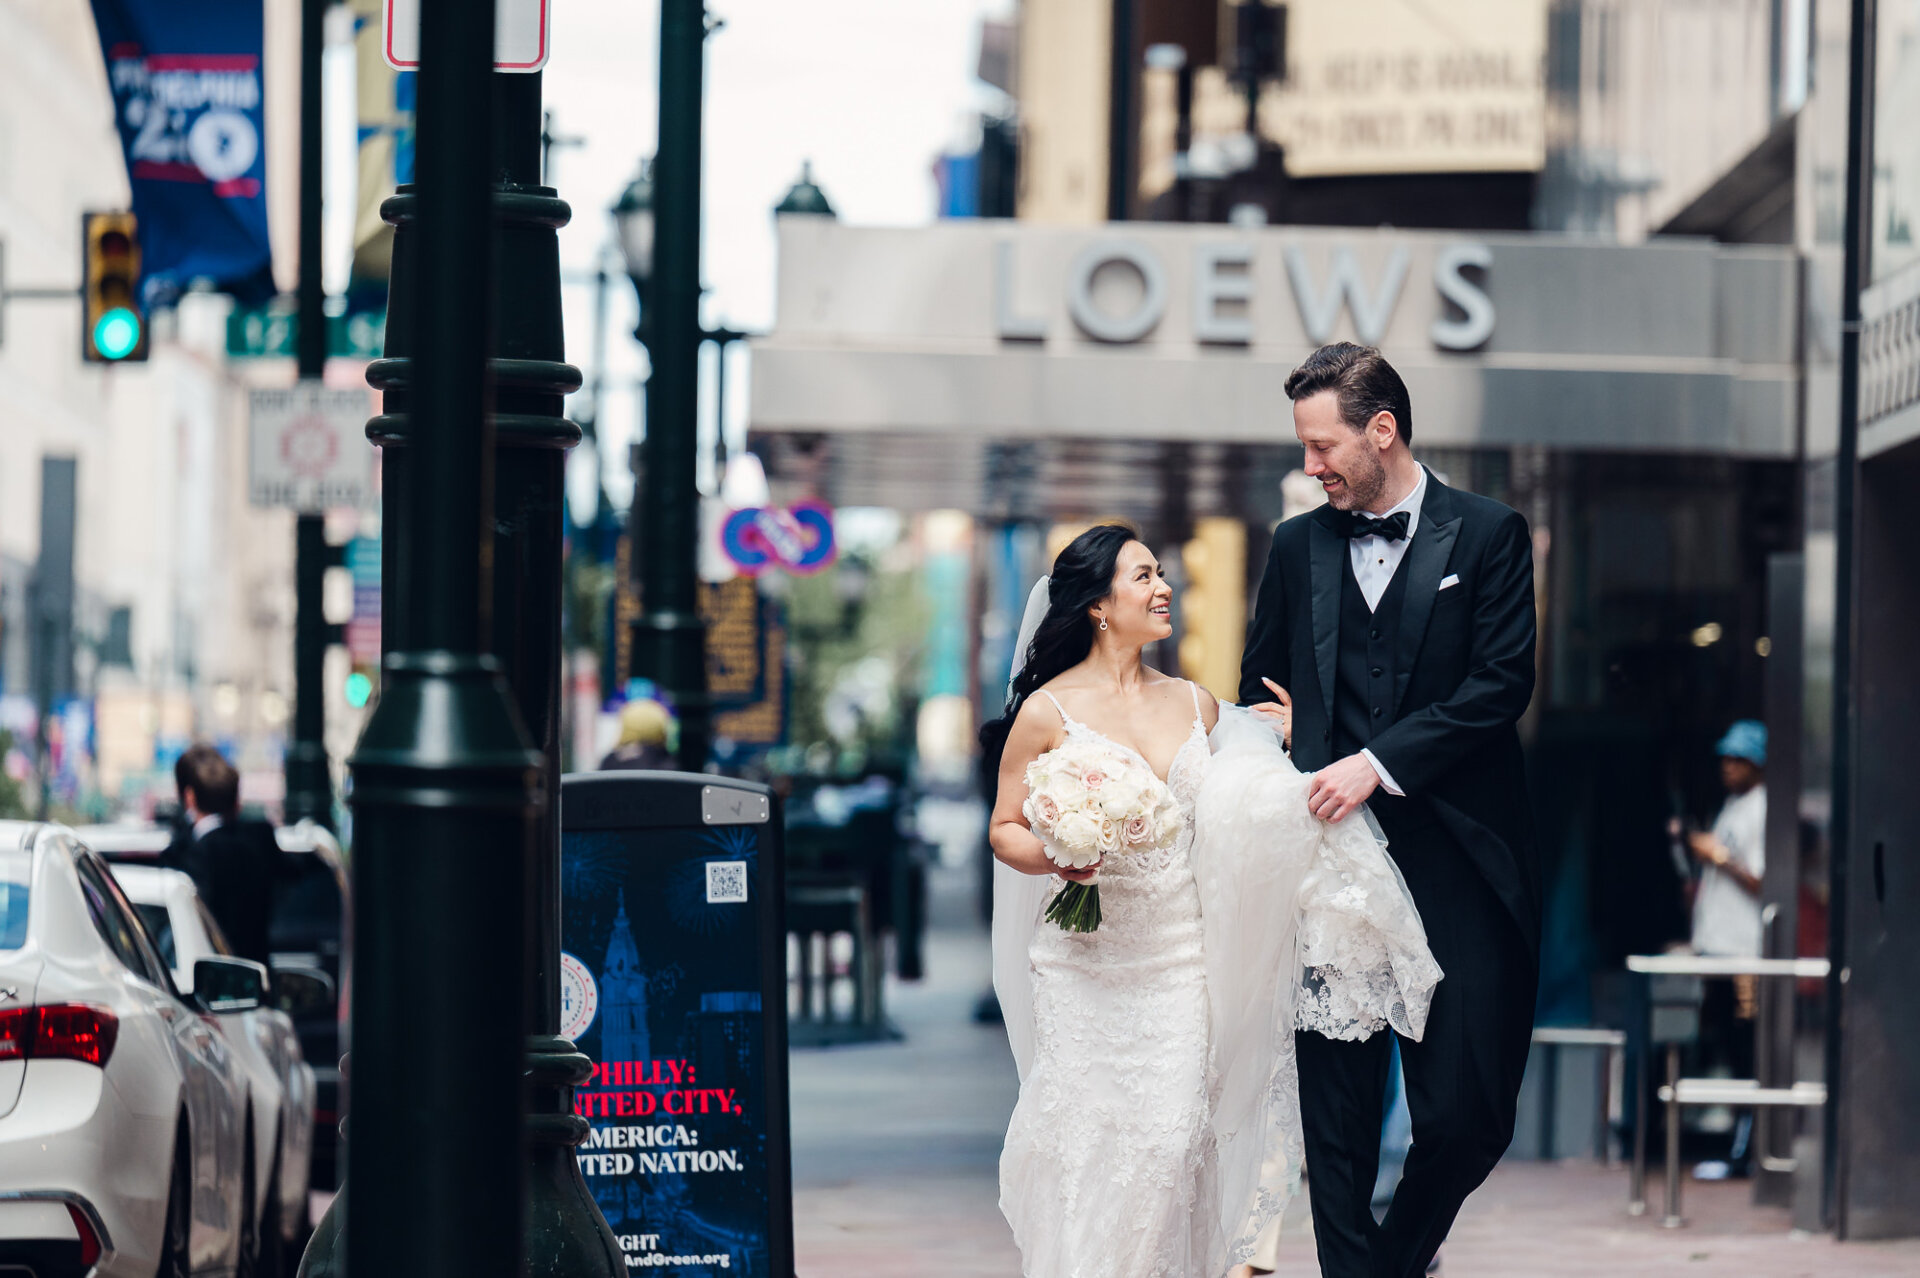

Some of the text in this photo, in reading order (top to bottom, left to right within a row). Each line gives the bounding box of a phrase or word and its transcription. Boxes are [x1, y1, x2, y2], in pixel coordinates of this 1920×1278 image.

[996, 238, 1497, 350] LOEWS
[574, 1088, 743, 1117] NITED CITY,
[639, 1149, 744, 1174] NATION.
[624, 1251, 730, 1268] AndGreen.org
